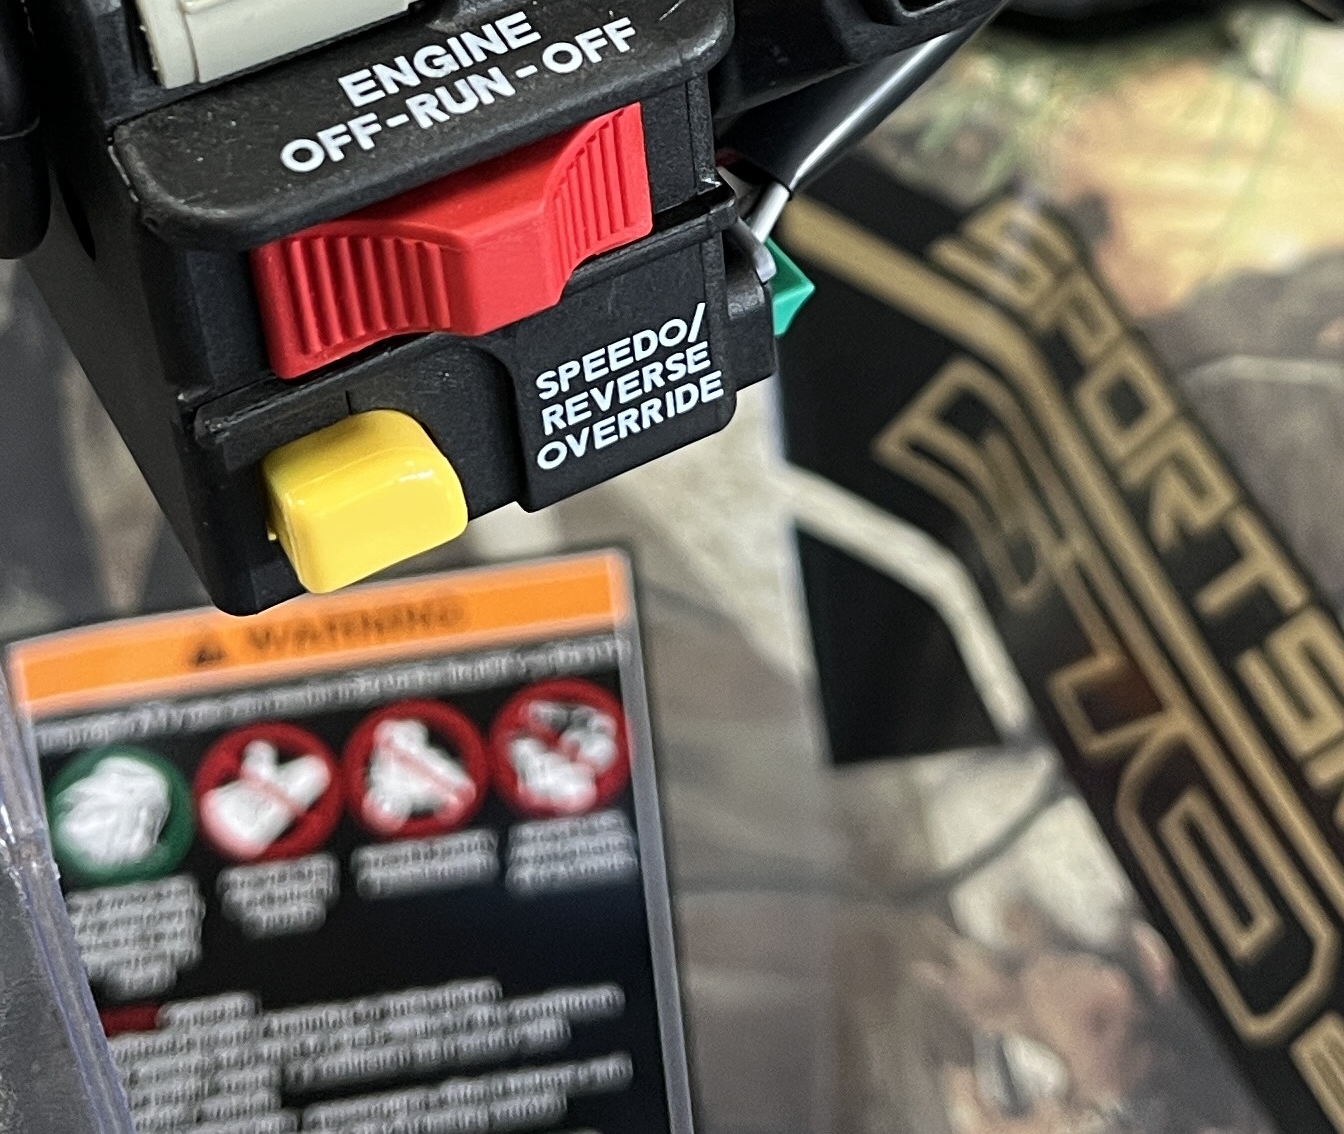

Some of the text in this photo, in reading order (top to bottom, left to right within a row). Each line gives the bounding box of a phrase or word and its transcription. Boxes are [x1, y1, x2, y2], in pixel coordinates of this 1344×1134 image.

[337, 10, 542, 108] ENGINE
[534, 302, 707, 401] SPEEDO/
[541, 341, 712, 436] REVERSE
[535, 371, 726, 472] OVERRIDE
